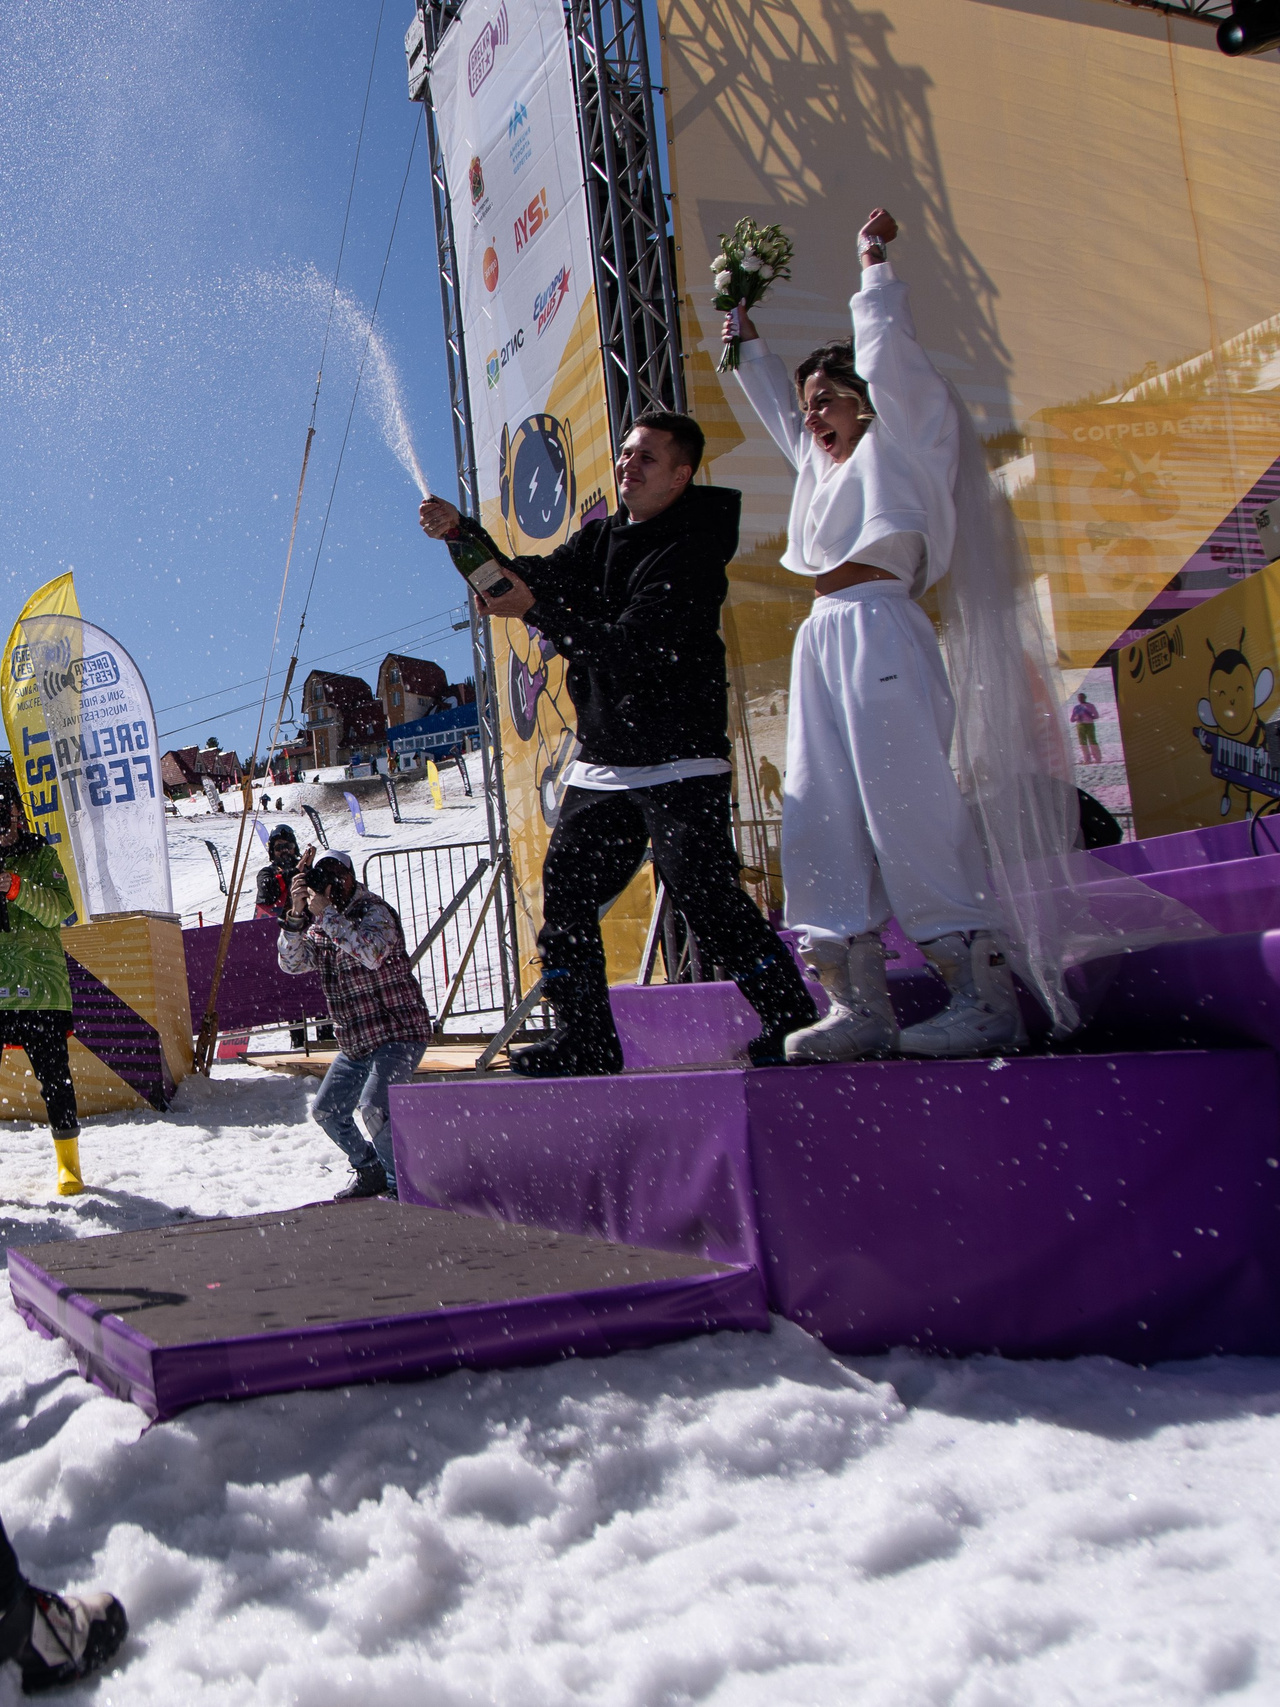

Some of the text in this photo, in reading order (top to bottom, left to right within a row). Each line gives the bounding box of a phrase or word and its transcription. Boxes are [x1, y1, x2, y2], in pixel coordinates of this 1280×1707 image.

[471, 31, 490, 71] GRELKA
[472, 57, 485, 89] FEST
[512, 141, 531, 164] КУРОРТА
[513, 148, 532, 175] ШЕРЕГЕШ
[514, 187, 550, 253] AYS!
[500, 328, 525, 368] 2ГИС
[17, 663, 33, 677] FES
